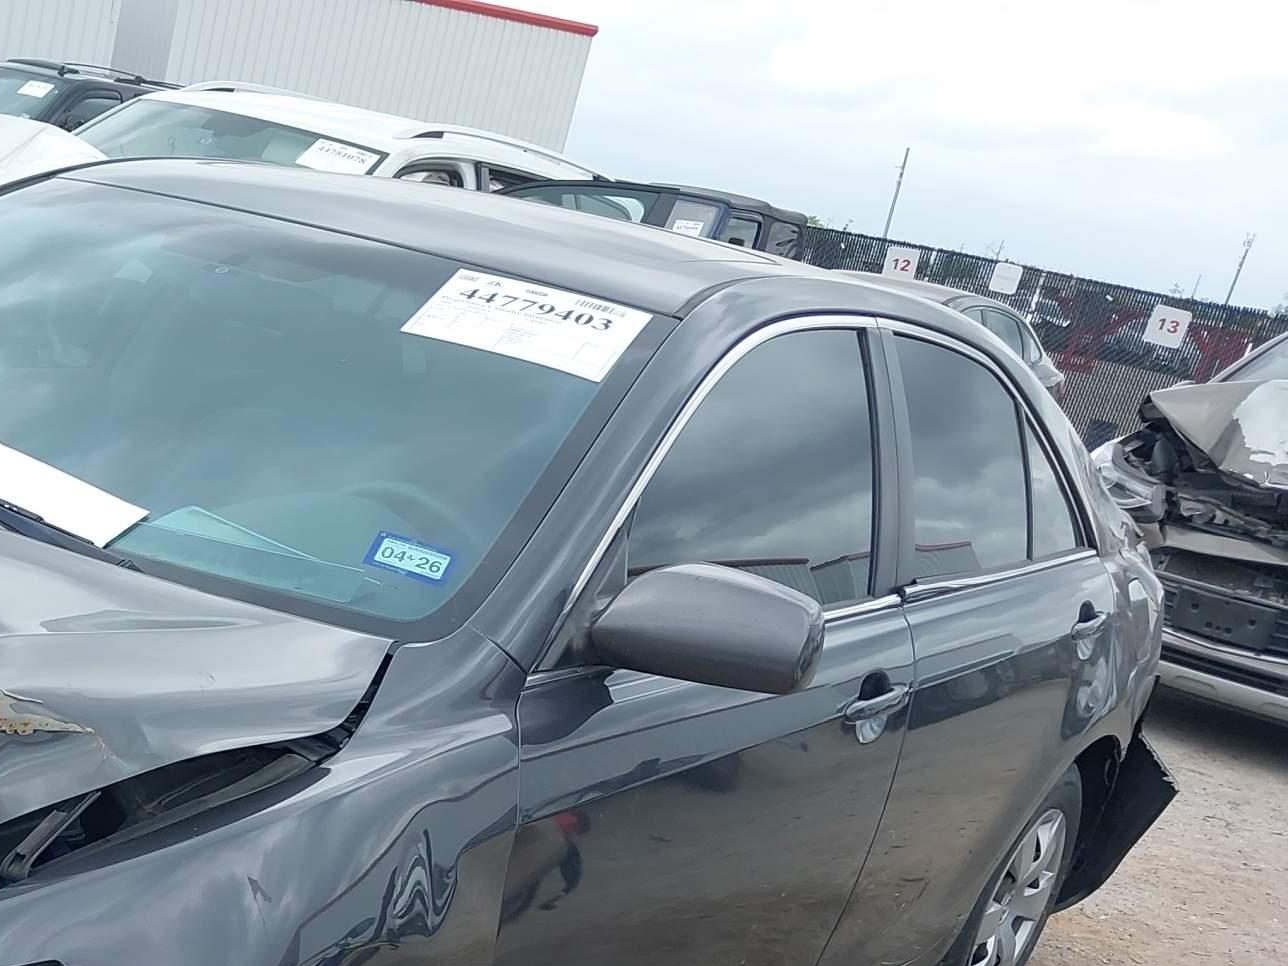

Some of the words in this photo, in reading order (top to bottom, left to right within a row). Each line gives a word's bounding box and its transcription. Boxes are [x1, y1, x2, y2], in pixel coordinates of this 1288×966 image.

[892, 258, 911, 272] 12
[459, 288, 614, 331] 44779403
[1158, 317, 1180, 334] 13
[381, 546, 407, 562] 04
[415, 556, 443, 573] 26
